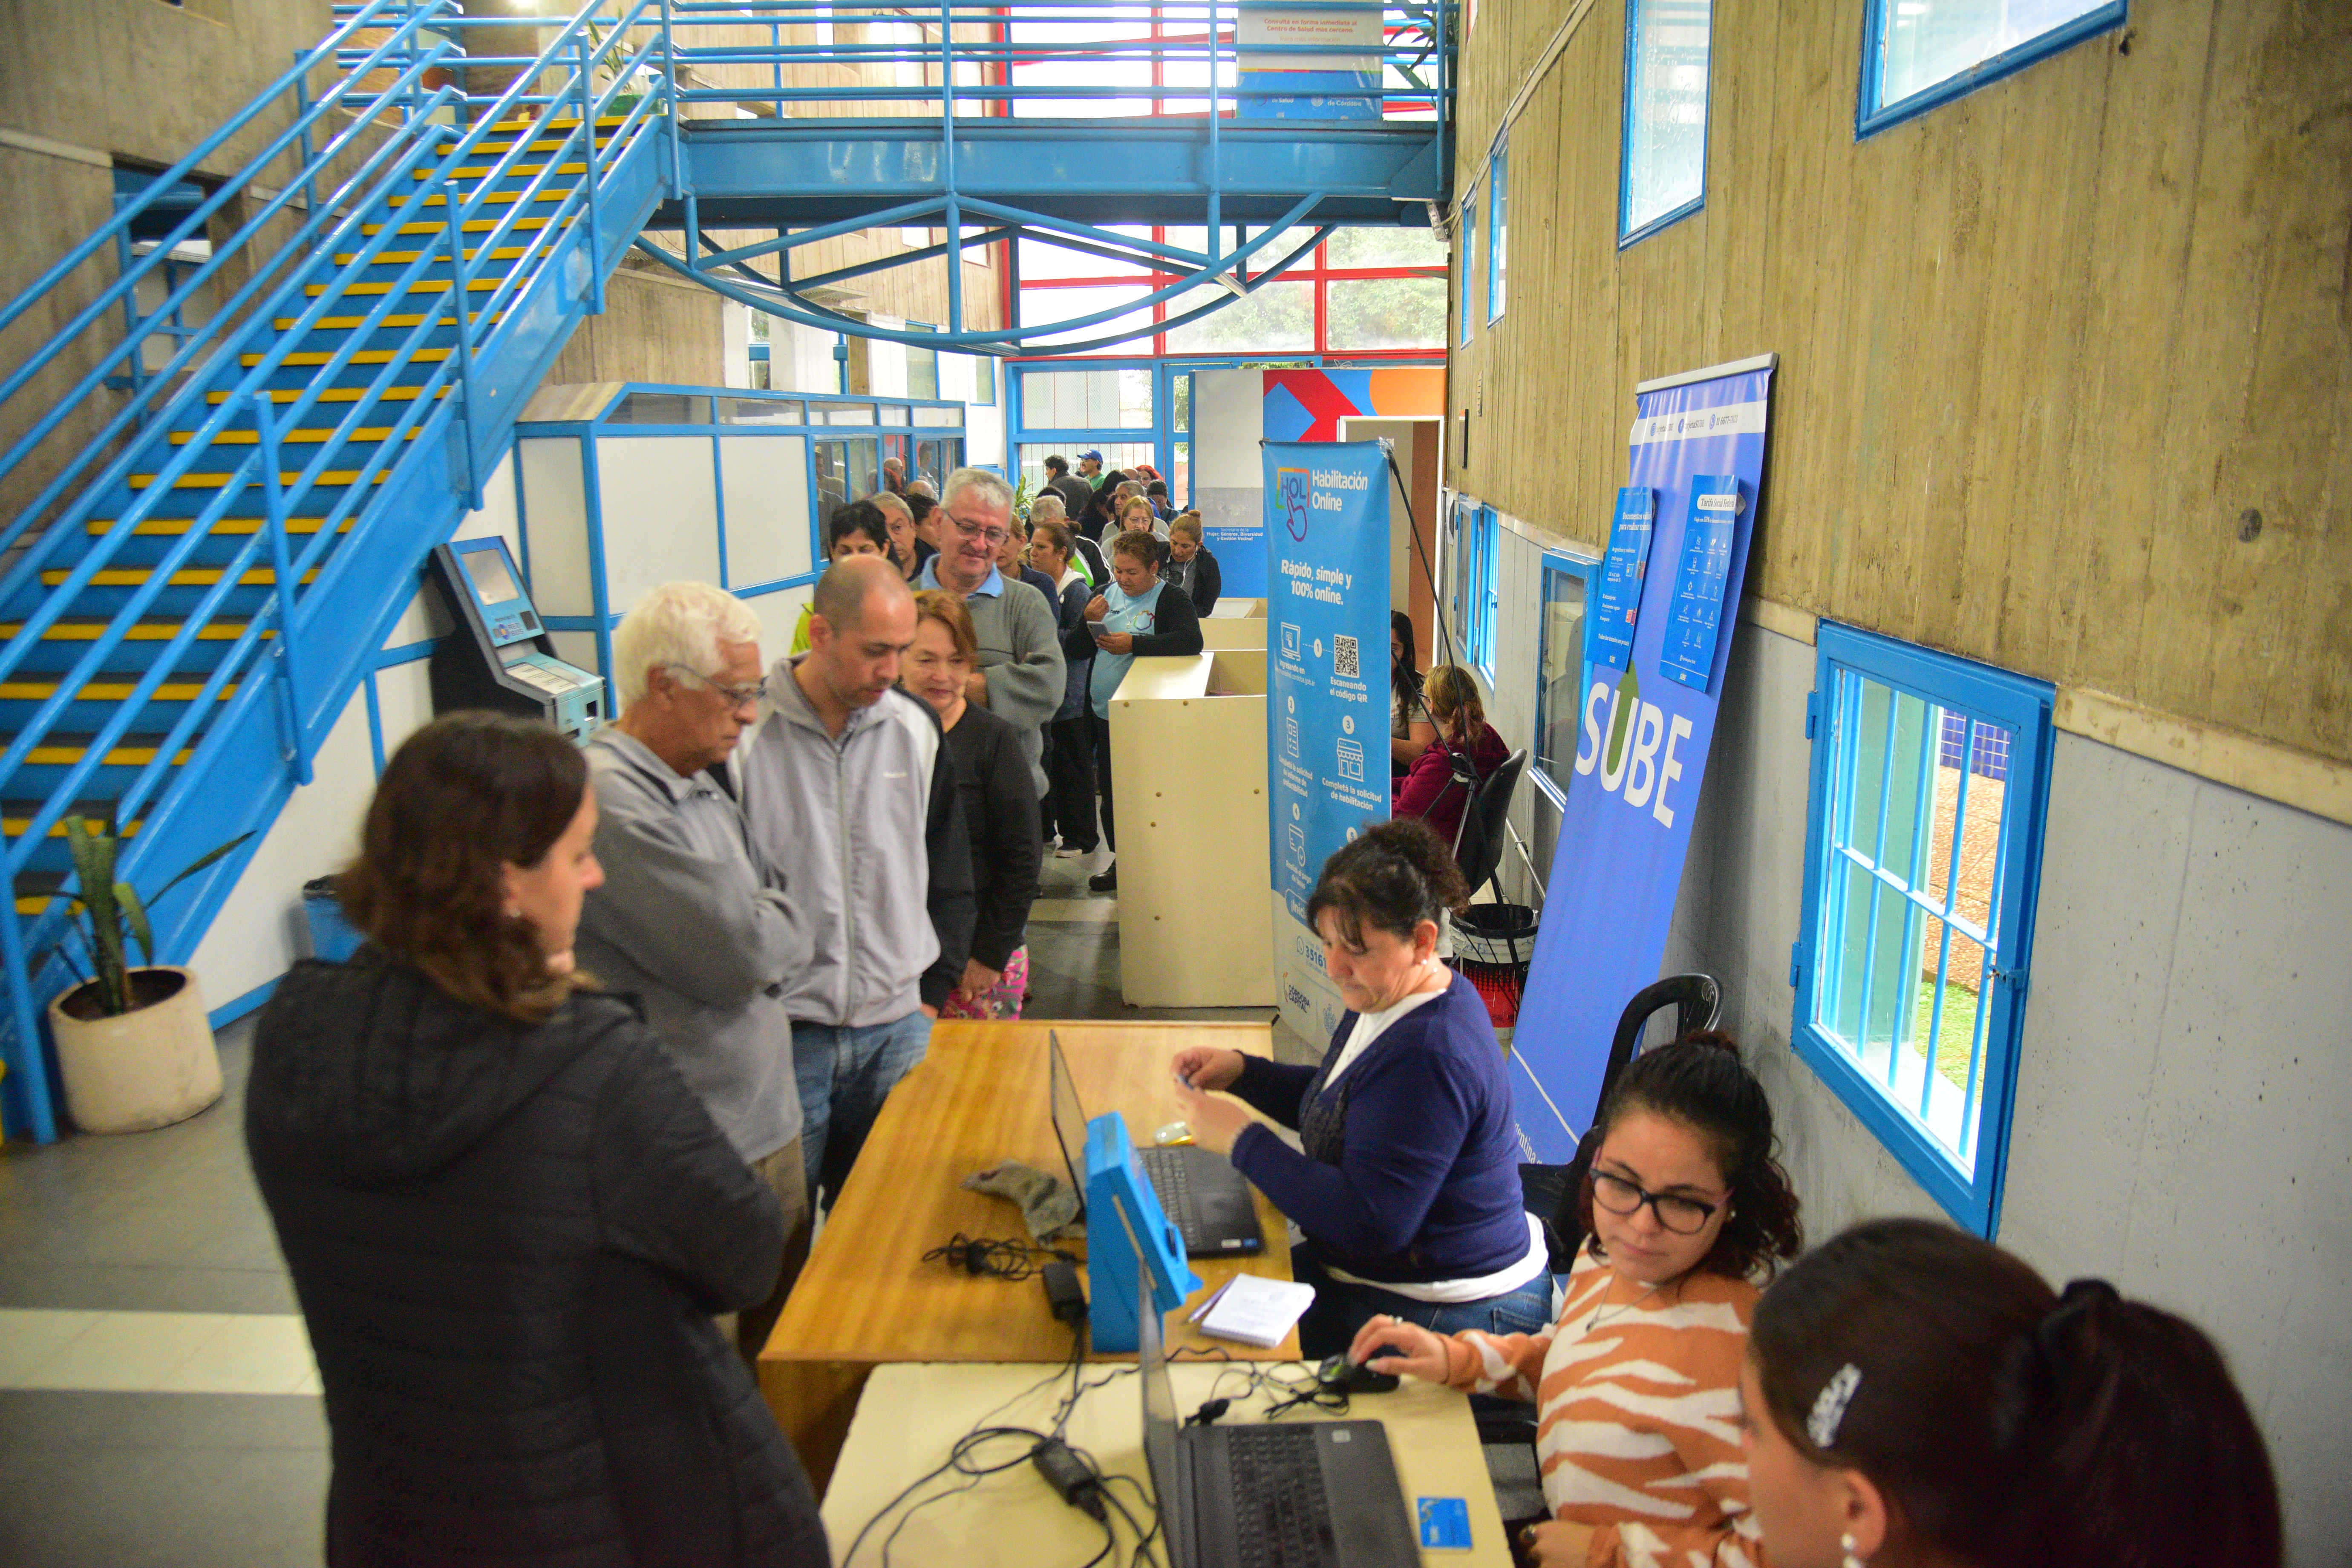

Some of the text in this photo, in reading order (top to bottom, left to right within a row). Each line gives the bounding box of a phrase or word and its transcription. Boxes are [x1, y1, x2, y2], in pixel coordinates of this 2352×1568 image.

[1281, 477, 1306, 499] HOL
[1312, 470, 1368, 490] Habilitación
[1312, 492, 1342, 511] Online
[1701, 498, 1713, 507] Tarifa
[1713, 499, 1723, 507] Social
[1618, 524, 1627, 532] para
[1281, 559, 1352, 590] Rápido, simple y
[1291, 580, 1343, 605] 100% online.
[1330, 676, 1366, 691] Escaneando
[1336, 689, 1356, 702] código
[1357, 693, 1367, 703] QR
[1575, 682, 1692, 829] SUBE
[1322, 777, 1381, 803] Completá la solicitud
[1331, 791, 1373, 811] de habilitación
[1288, 992, 1307, 1013] CAPITAL
